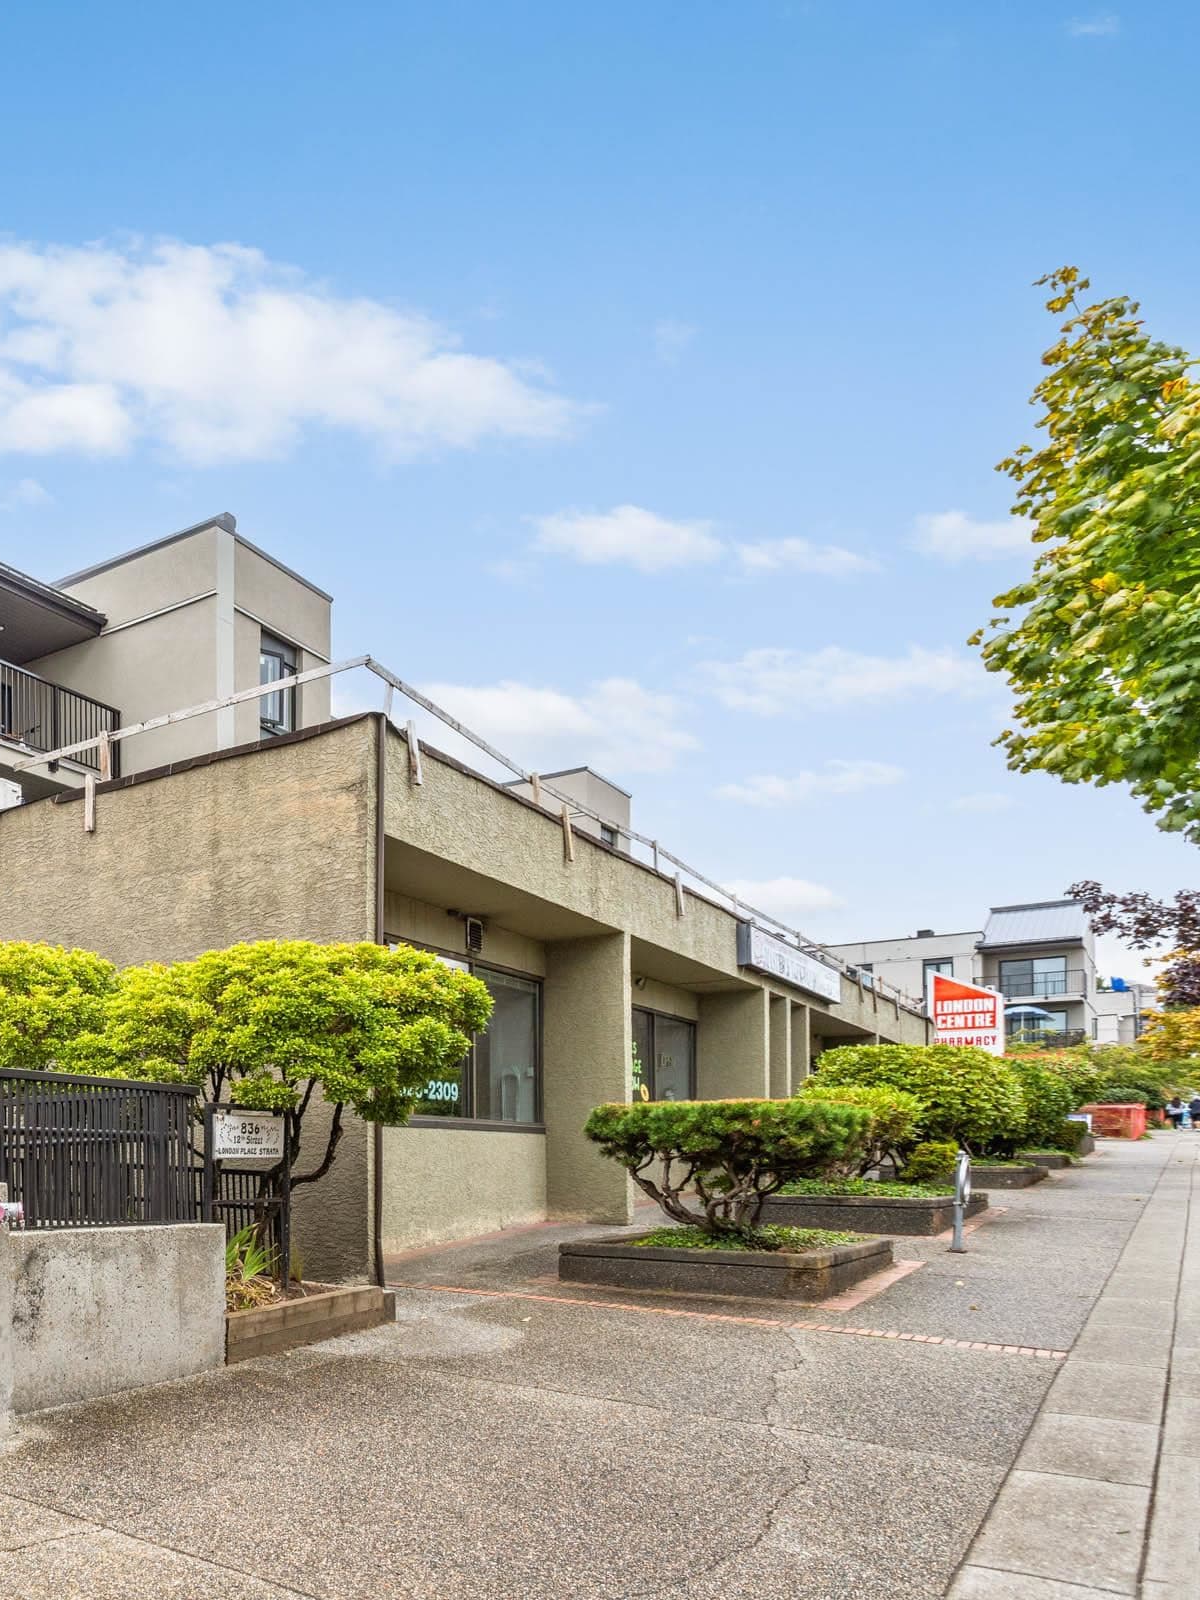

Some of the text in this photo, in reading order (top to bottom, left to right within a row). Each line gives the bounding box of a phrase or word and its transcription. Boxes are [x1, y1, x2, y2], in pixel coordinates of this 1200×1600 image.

[936, 998, 995, 1014] LONDON
[936, 1012, 994, 1029] CENTRE
[934, 1035, 996, 1046] PHARMACY
[240, 1122, 260, 1135] 836
[246, 1135, 263, 1144] Street
[240, 1147, 257, 1155] PLACE
[259, 1147, 279, 1155] STRATA
